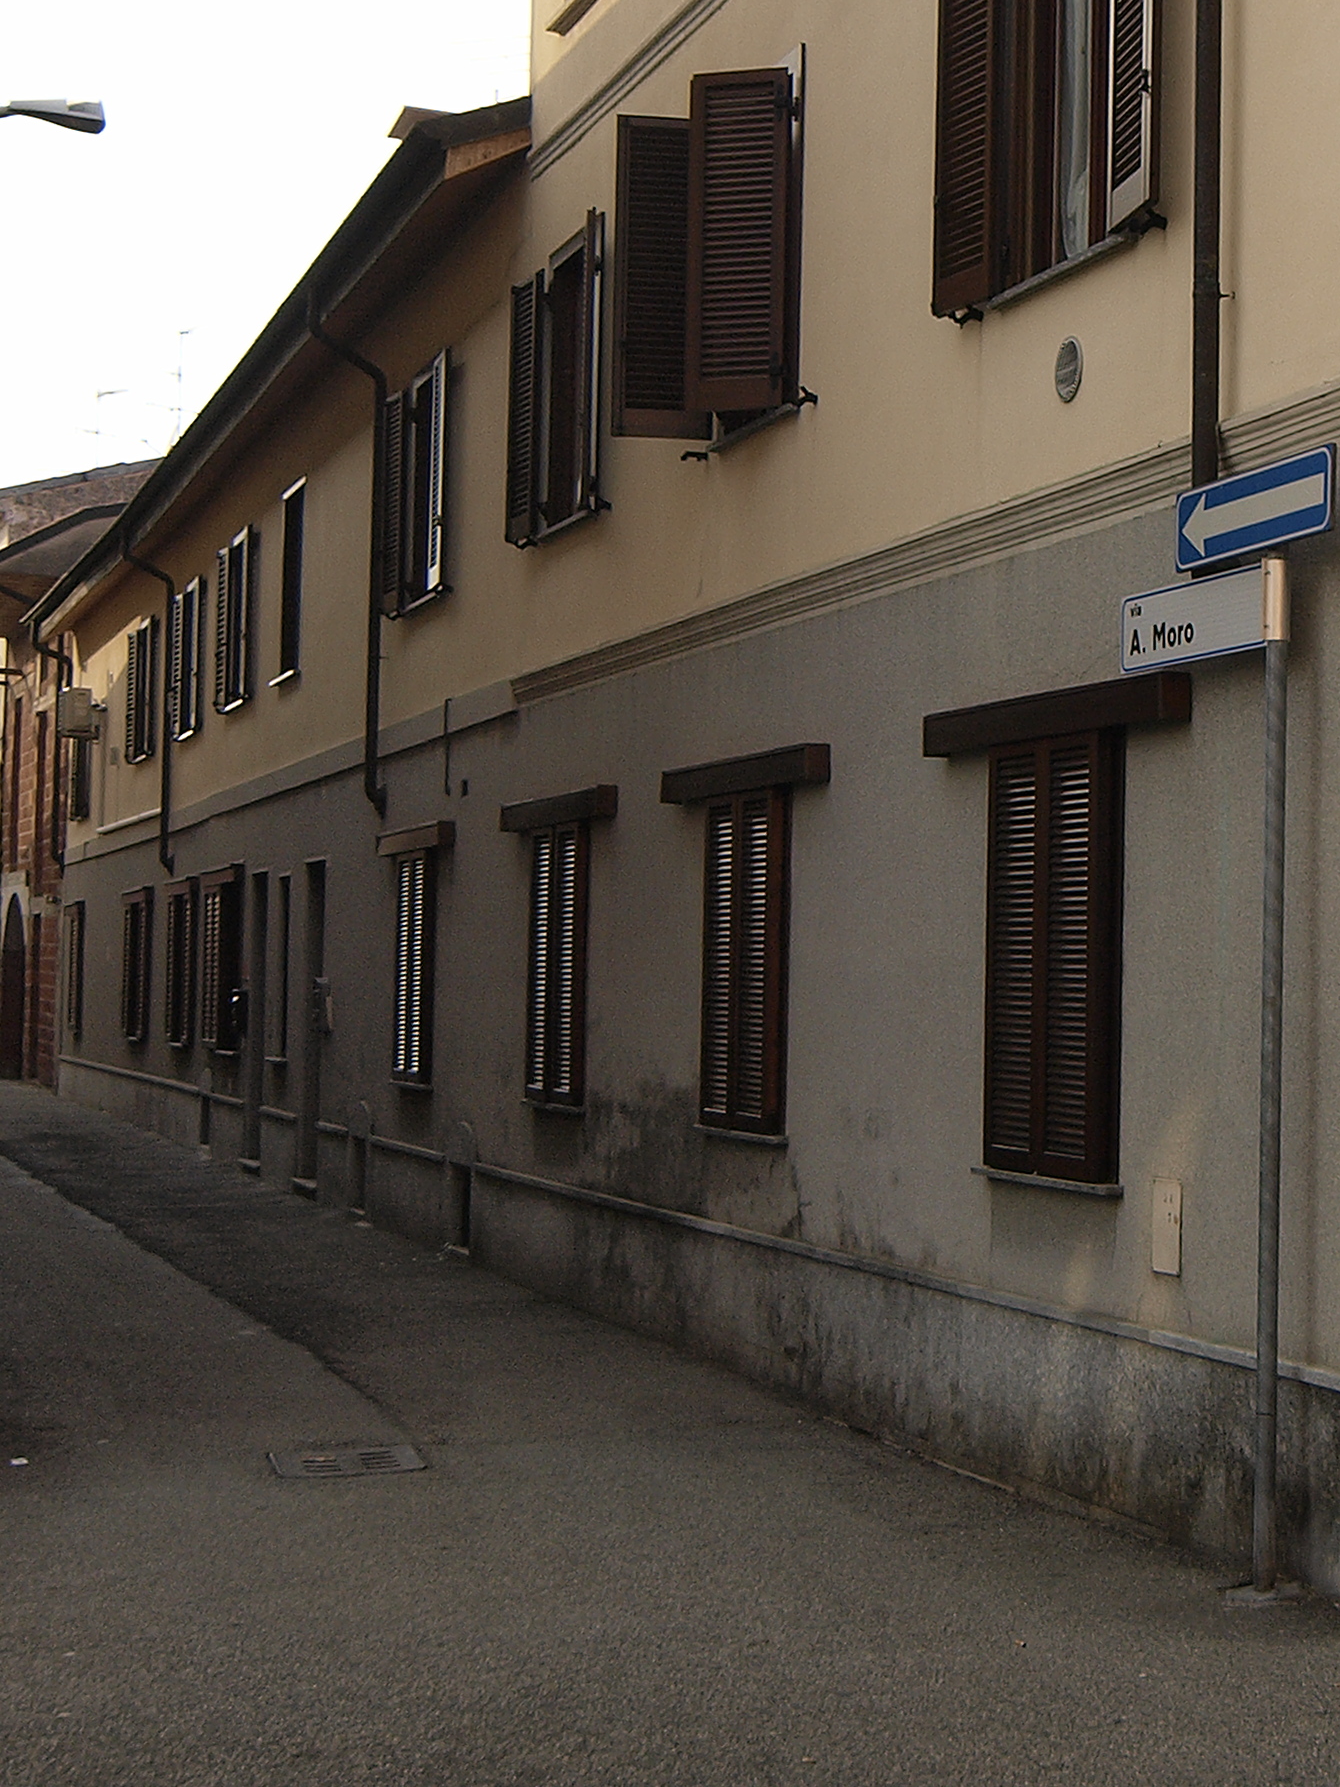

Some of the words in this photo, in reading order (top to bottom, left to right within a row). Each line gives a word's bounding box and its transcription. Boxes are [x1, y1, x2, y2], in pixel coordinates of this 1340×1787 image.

[1130, 603, 1142, 617] via
[1130, 629, 1146, 656] A.
[1153, 622, 1194, 651] Moro
